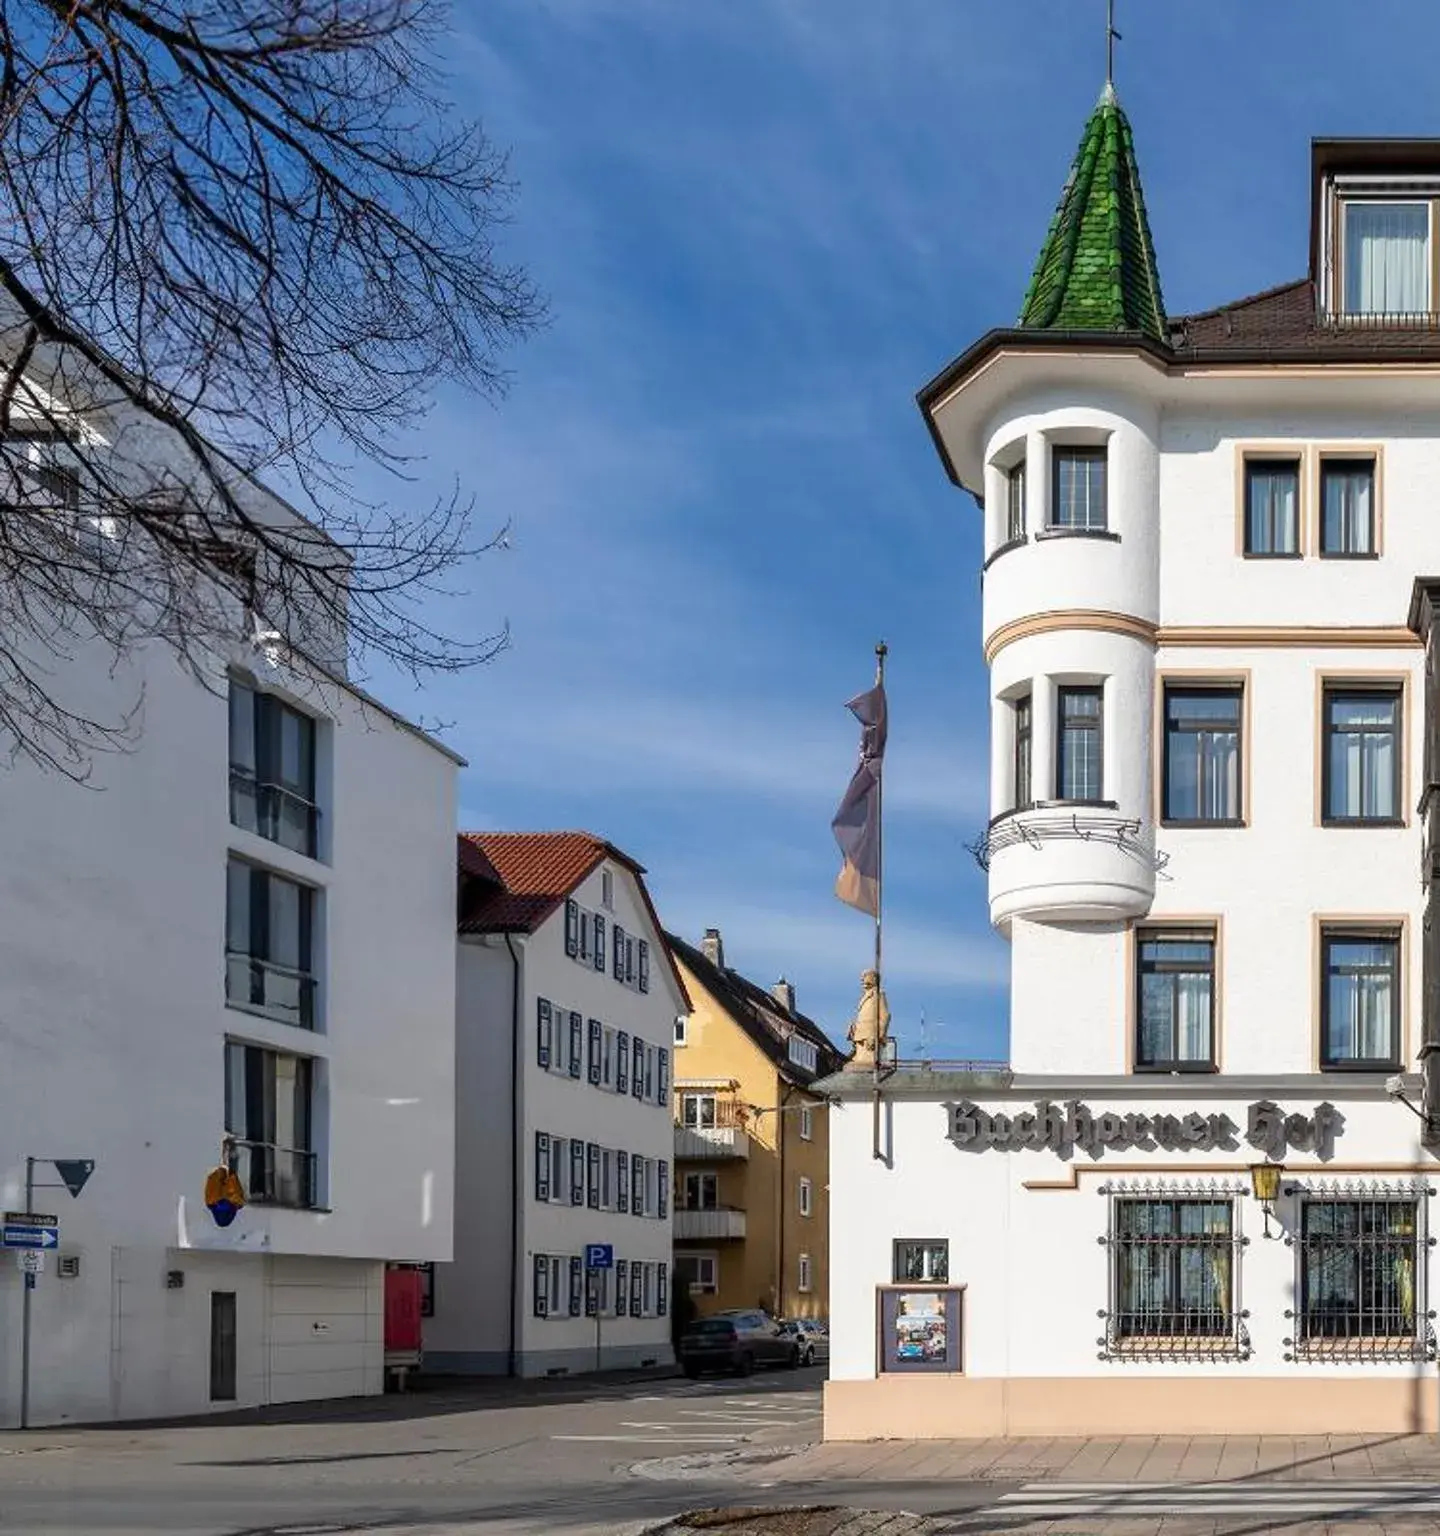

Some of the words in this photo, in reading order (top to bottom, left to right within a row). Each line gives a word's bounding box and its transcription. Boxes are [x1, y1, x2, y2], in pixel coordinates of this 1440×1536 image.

[942, 1100, 1239, 1161] Buchhorner
[1244, 1100, 1346, 1162] Hof
[590, 1247, 606, 1266] P
